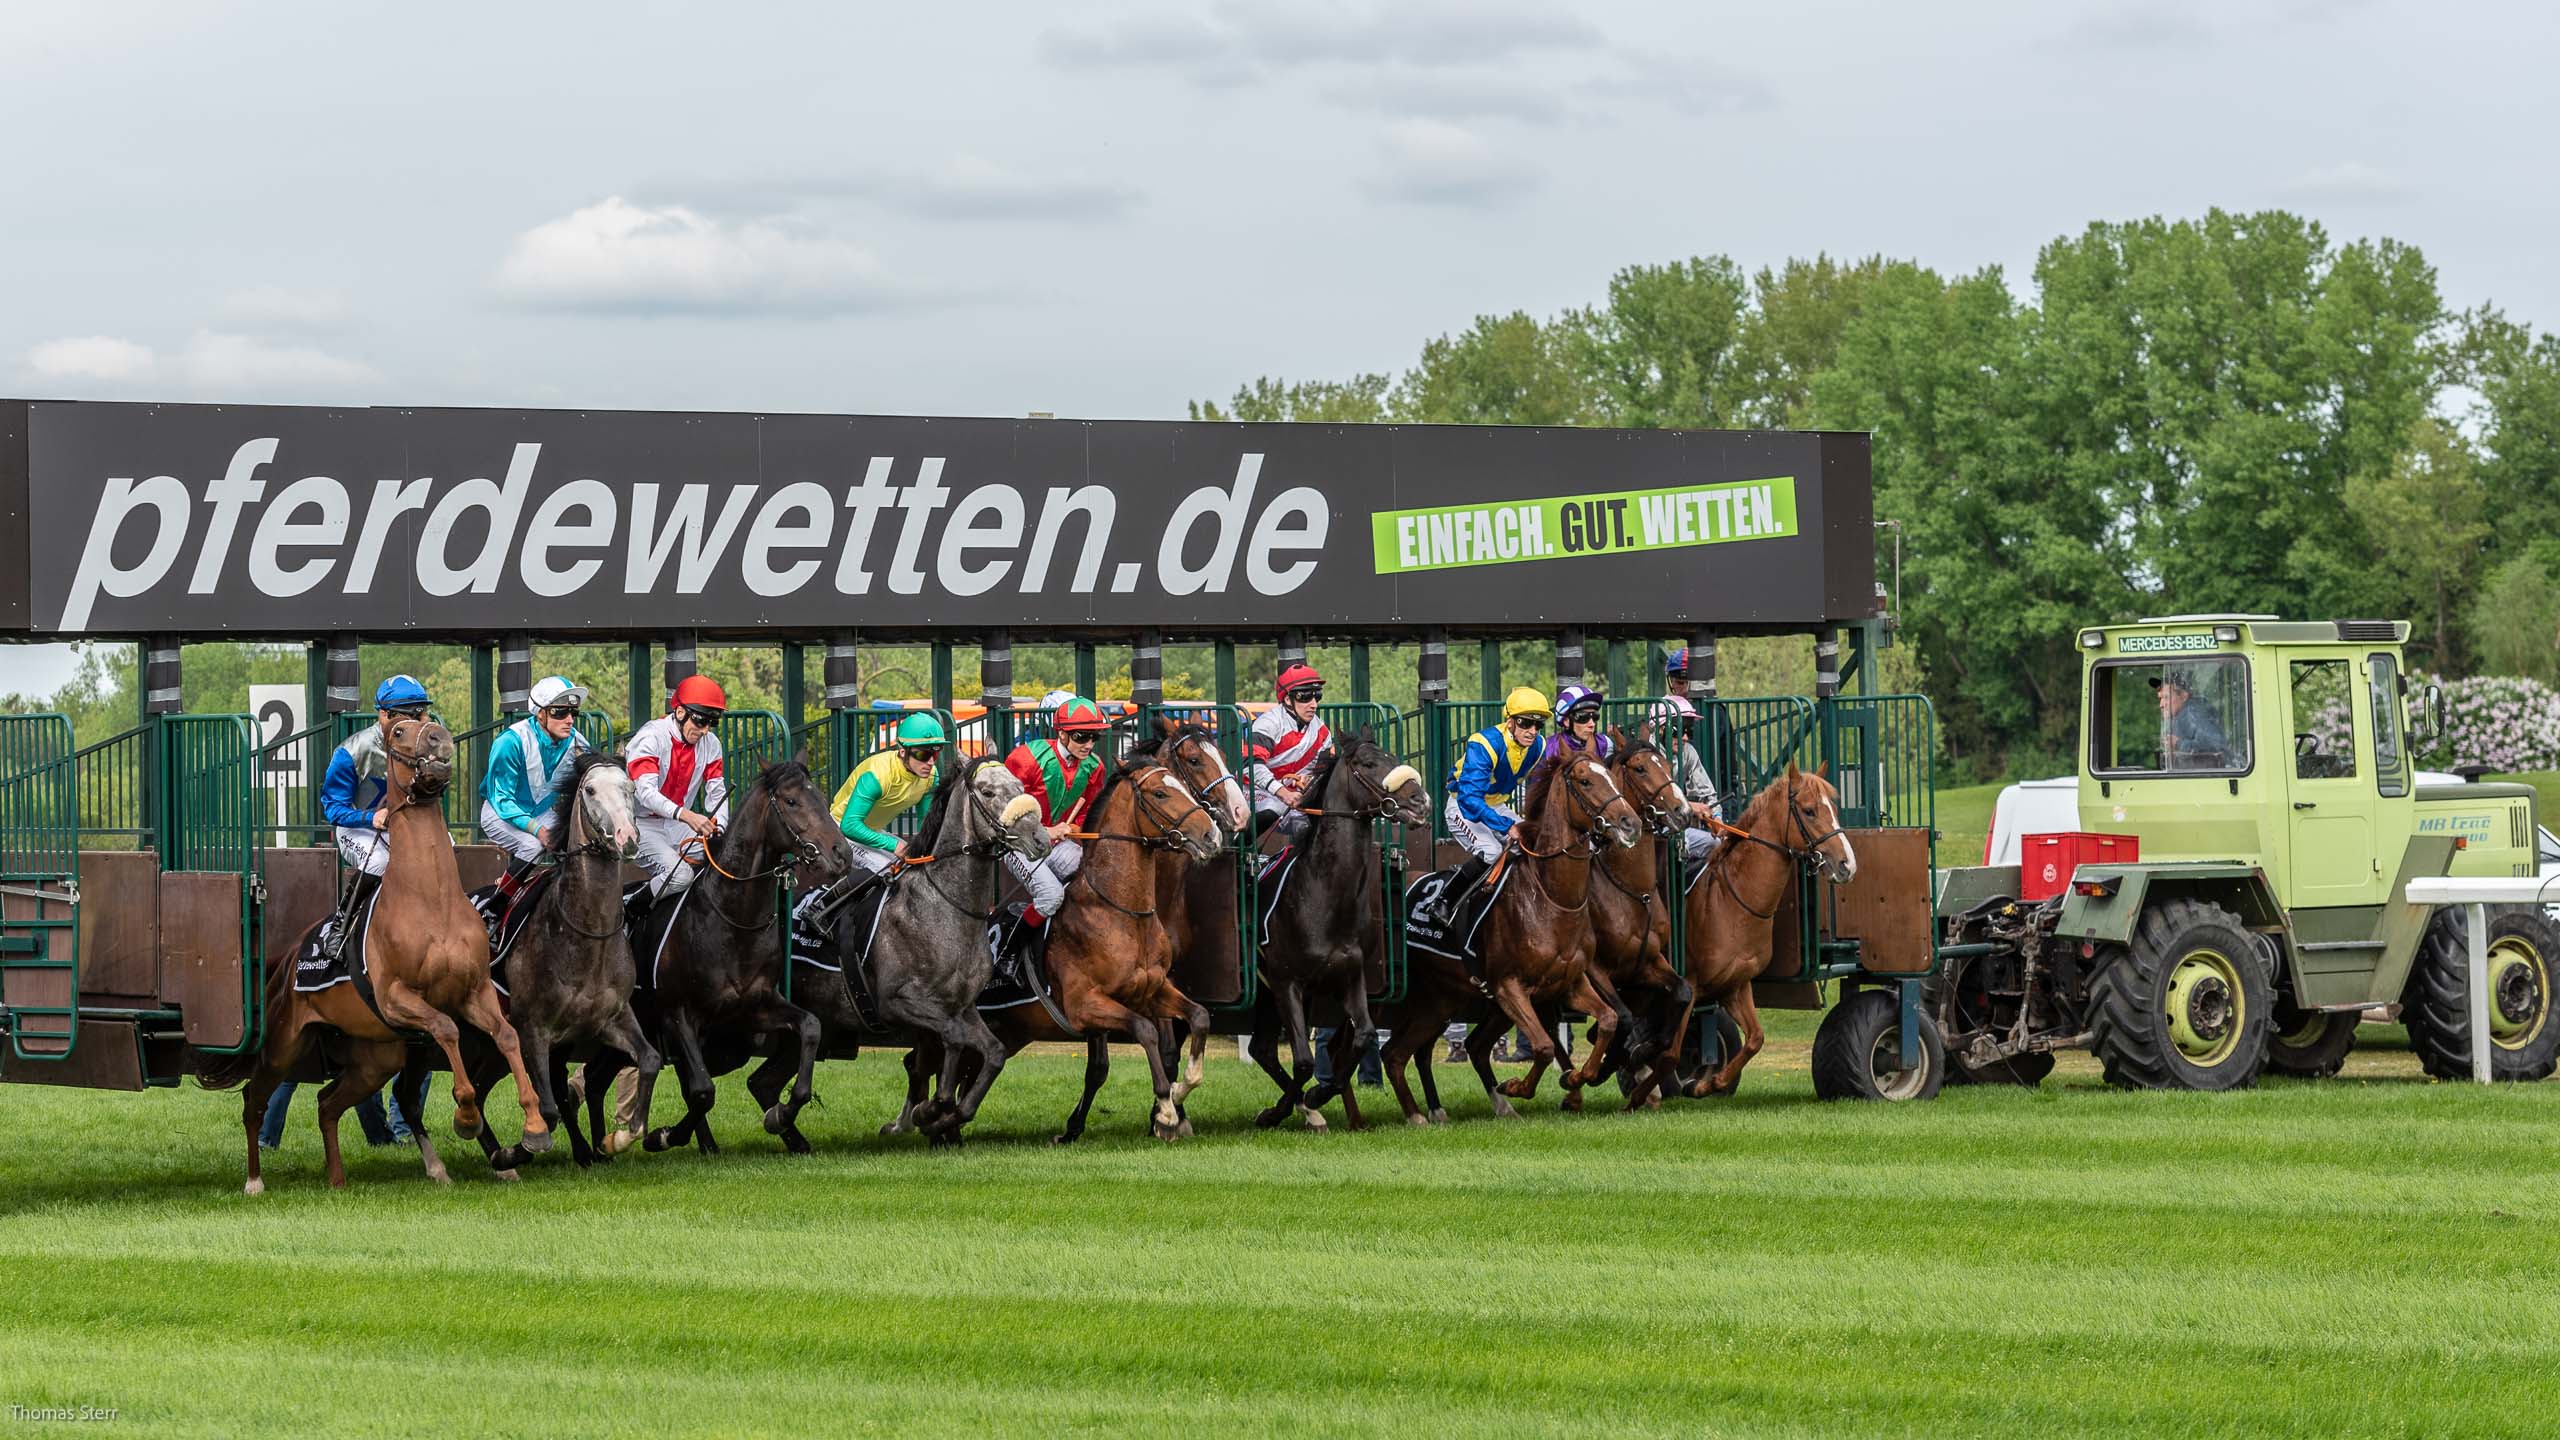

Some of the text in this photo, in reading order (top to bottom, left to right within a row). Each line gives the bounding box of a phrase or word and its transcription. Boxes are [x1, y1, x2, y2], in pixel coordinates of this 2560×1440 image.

[58, 438, 1329, 631] pferdewetten.de
[1397, 485, 1783, 568] EINFACH. GUT. WETTEN.
[2120, 635, 2218, 652] MERCEDES-BENZ
[259, 700, 302, 772] 2
[2419, 818, 2447, 832] MB
[1411, 879, 1444, 923] 2
